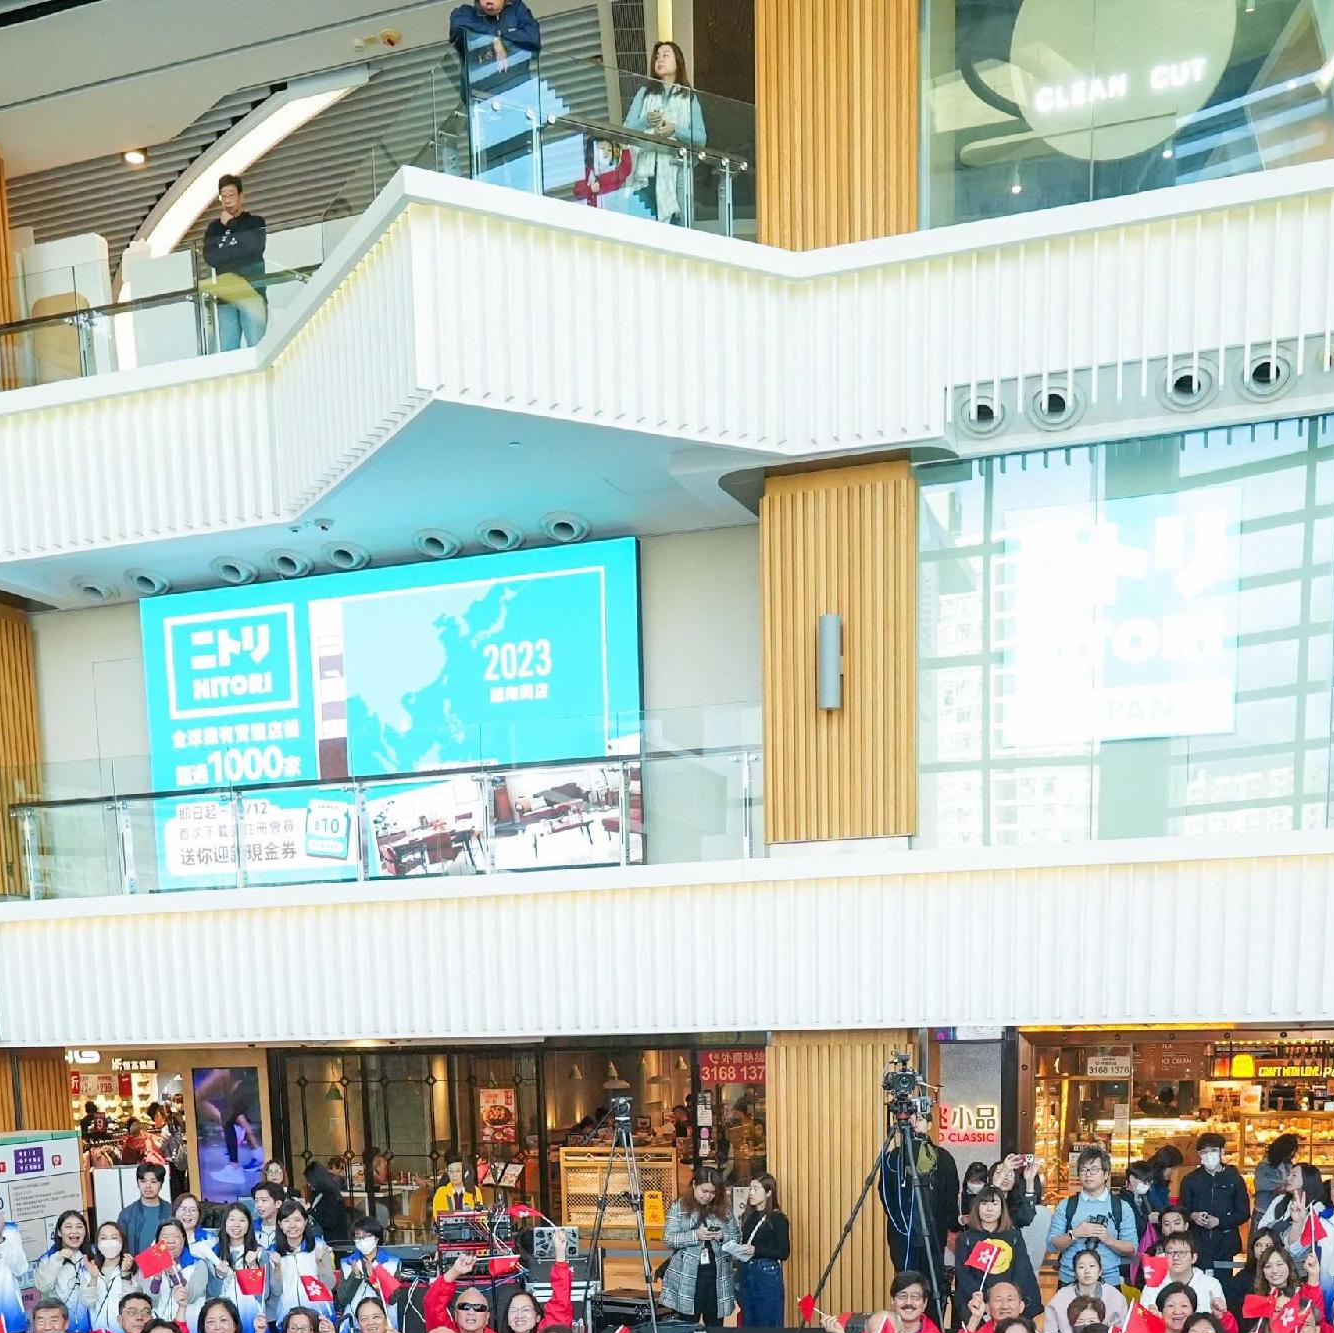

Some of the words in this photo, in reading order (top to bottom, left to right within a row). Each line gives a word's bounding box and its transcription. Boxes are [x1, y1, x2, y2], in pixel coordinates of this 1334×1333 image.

[1035, 73, 1127, 112] CLEAN
[1151, 57, 1206, 90] CUT
[190, 624, 270, 670] ニトリ
[483, 639, 552, 681] 2023
[193, 672, 272, 700] NITORI
[701, 1066, 736, 1081] 3168
[1089, 1066, 1108, 1074] 3168
[1112, 1065, 1130, 1074] 1376
[1258, 1066, 1281, 1077] CRAFT
[1300, 1066, 1320, 1077] LOVE
[948, 1132, 995, 1143] CLASSIC
